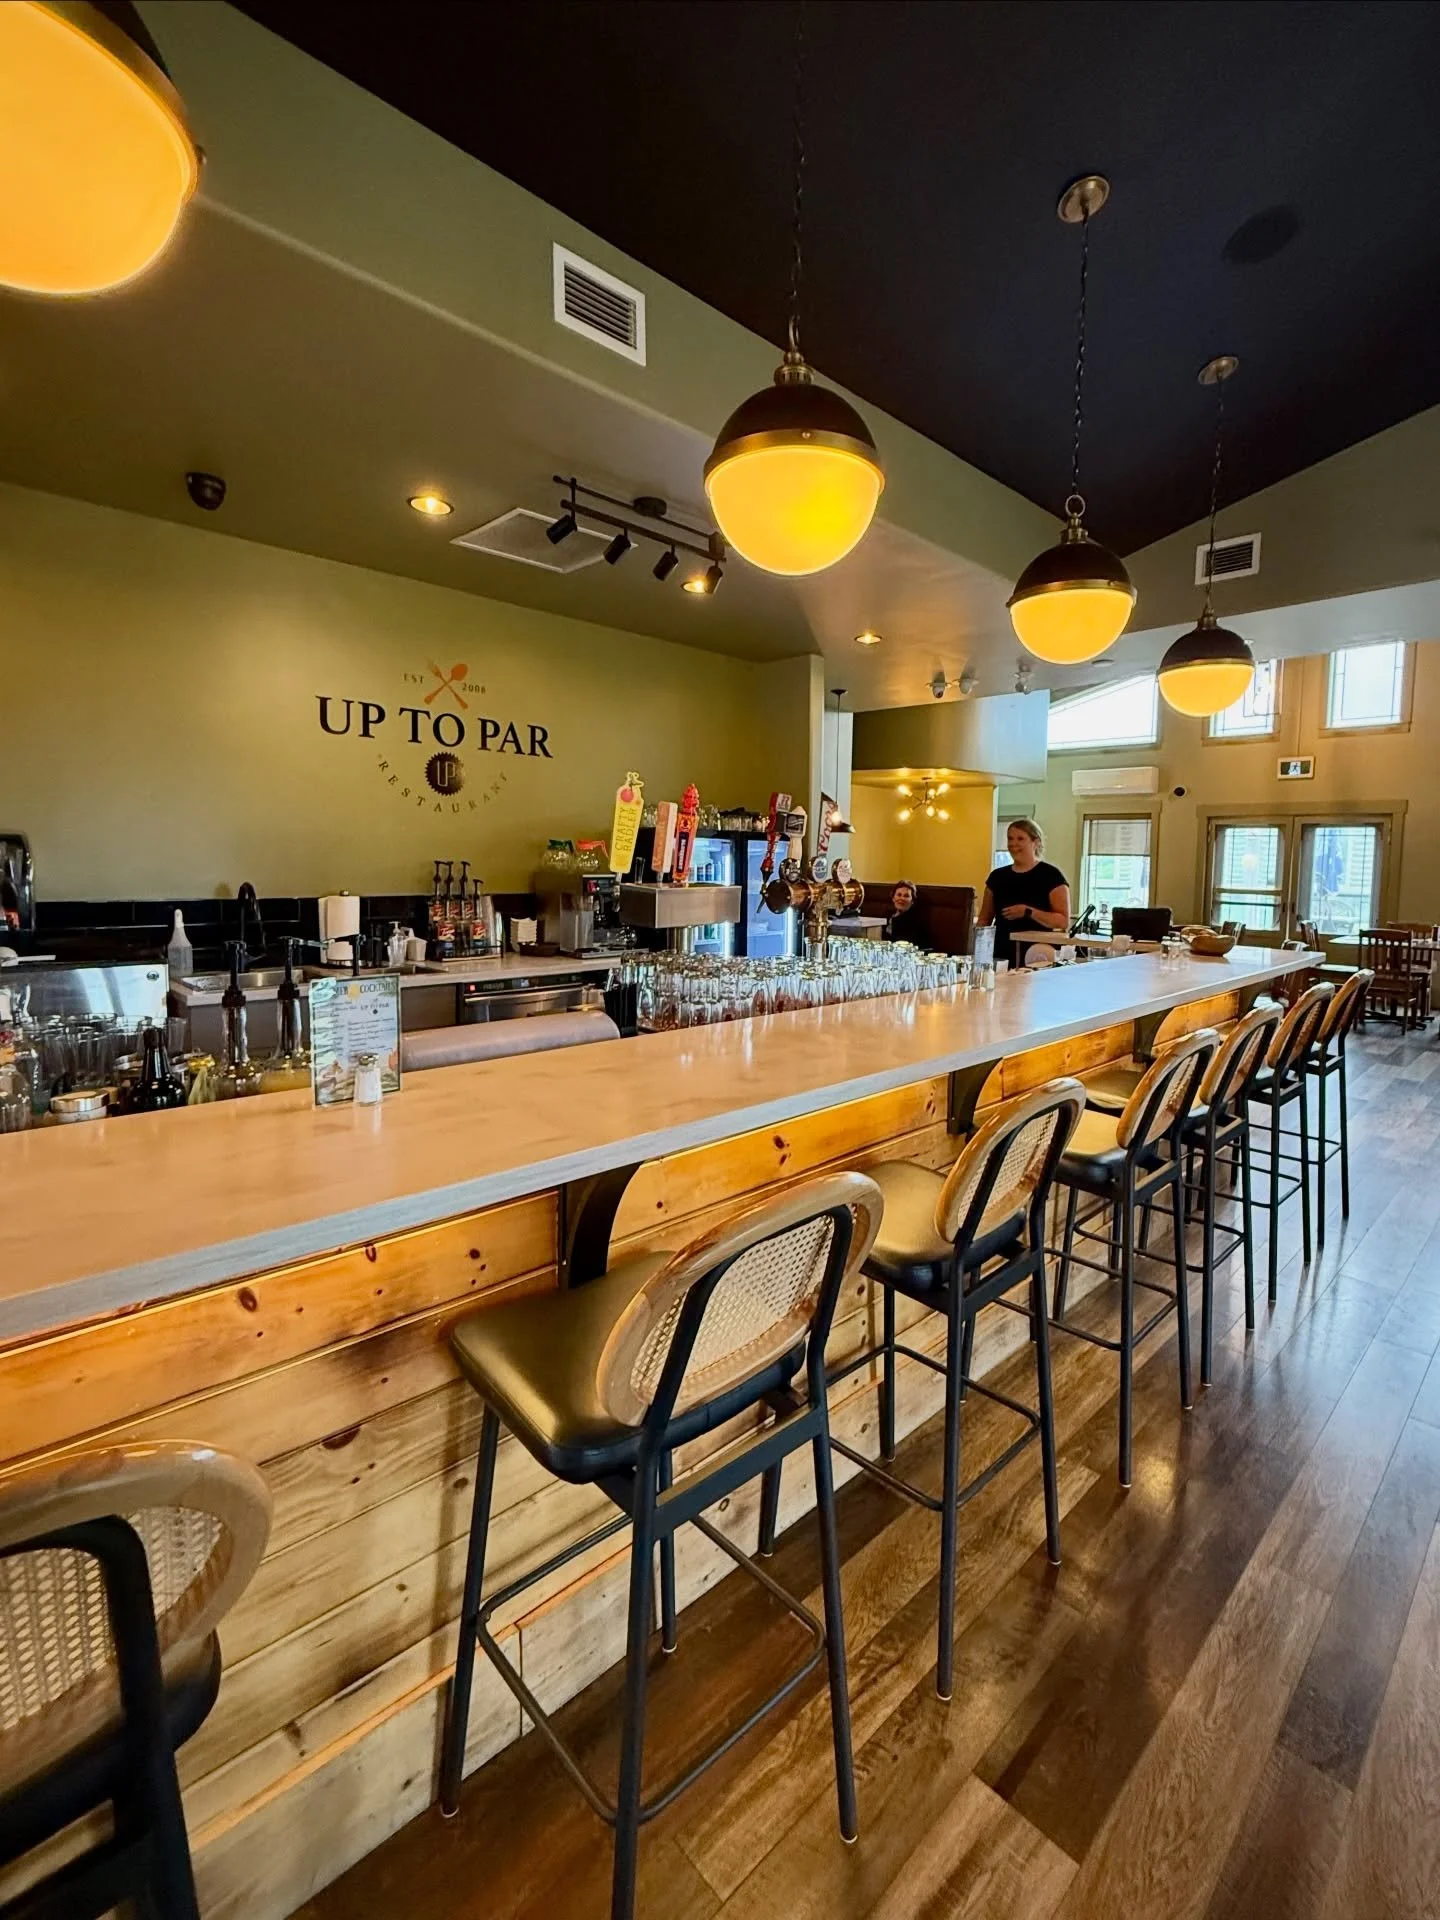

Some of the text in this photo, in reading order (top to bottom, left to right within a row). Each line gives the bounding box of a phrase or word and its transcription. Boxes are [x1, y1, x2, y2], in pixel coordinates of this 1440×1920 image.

[315, 695, 554, 759] UP TO PAR
[379, 760, 507, 814] RESTAURANT
[614, 807, 629, 852] CRAFTY
[623, 807, 638, 852] RADLER
